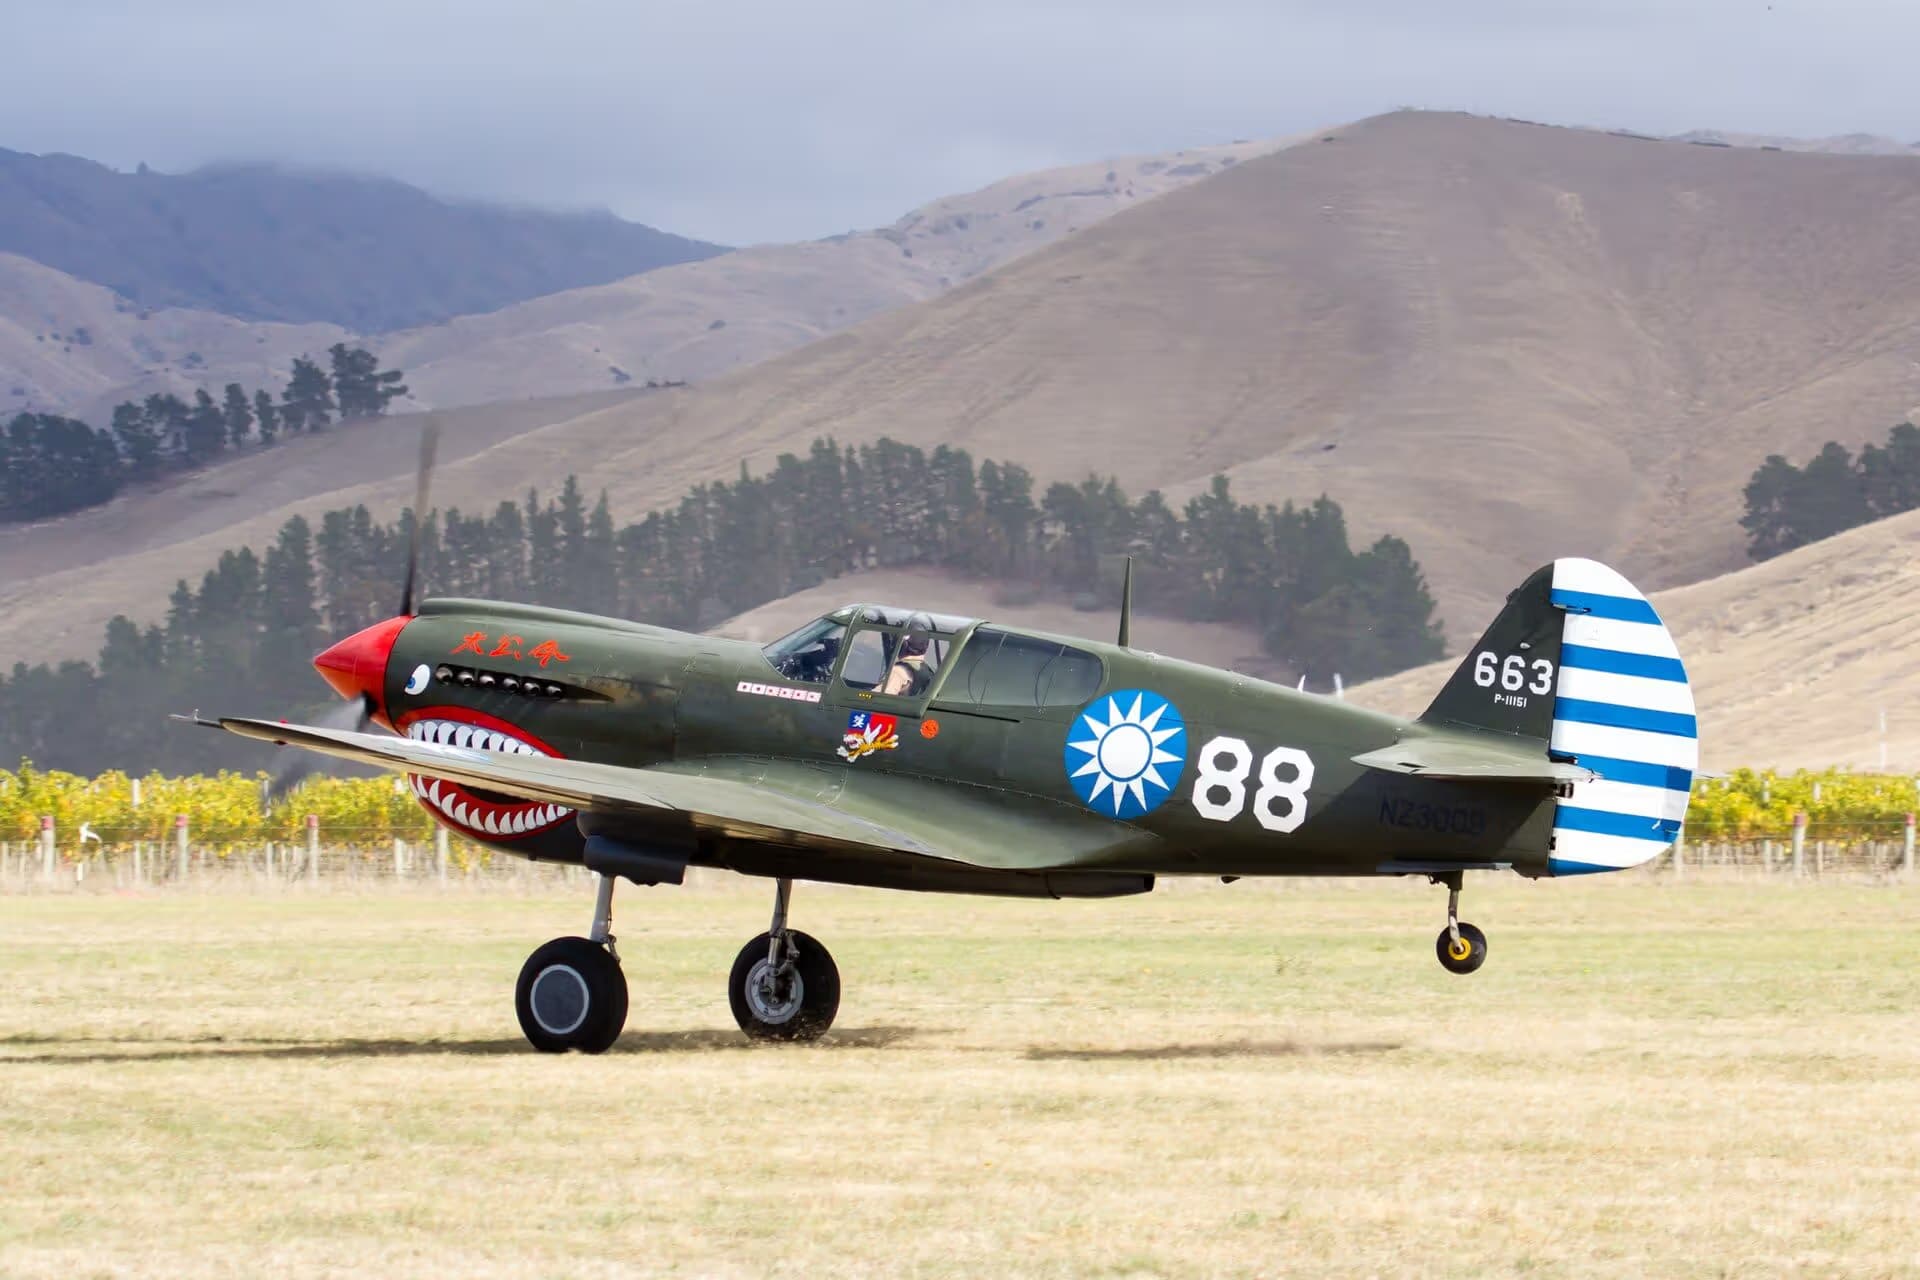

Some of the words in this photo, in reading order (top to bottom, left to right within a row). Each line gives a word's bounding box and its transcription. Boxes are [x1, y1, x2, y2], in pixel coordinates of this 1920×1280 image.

[1474, 651, 1553, 695] 663
[1494, 694, 1527, 708] P-11151
[1192, 736, 1315, 834] 88
